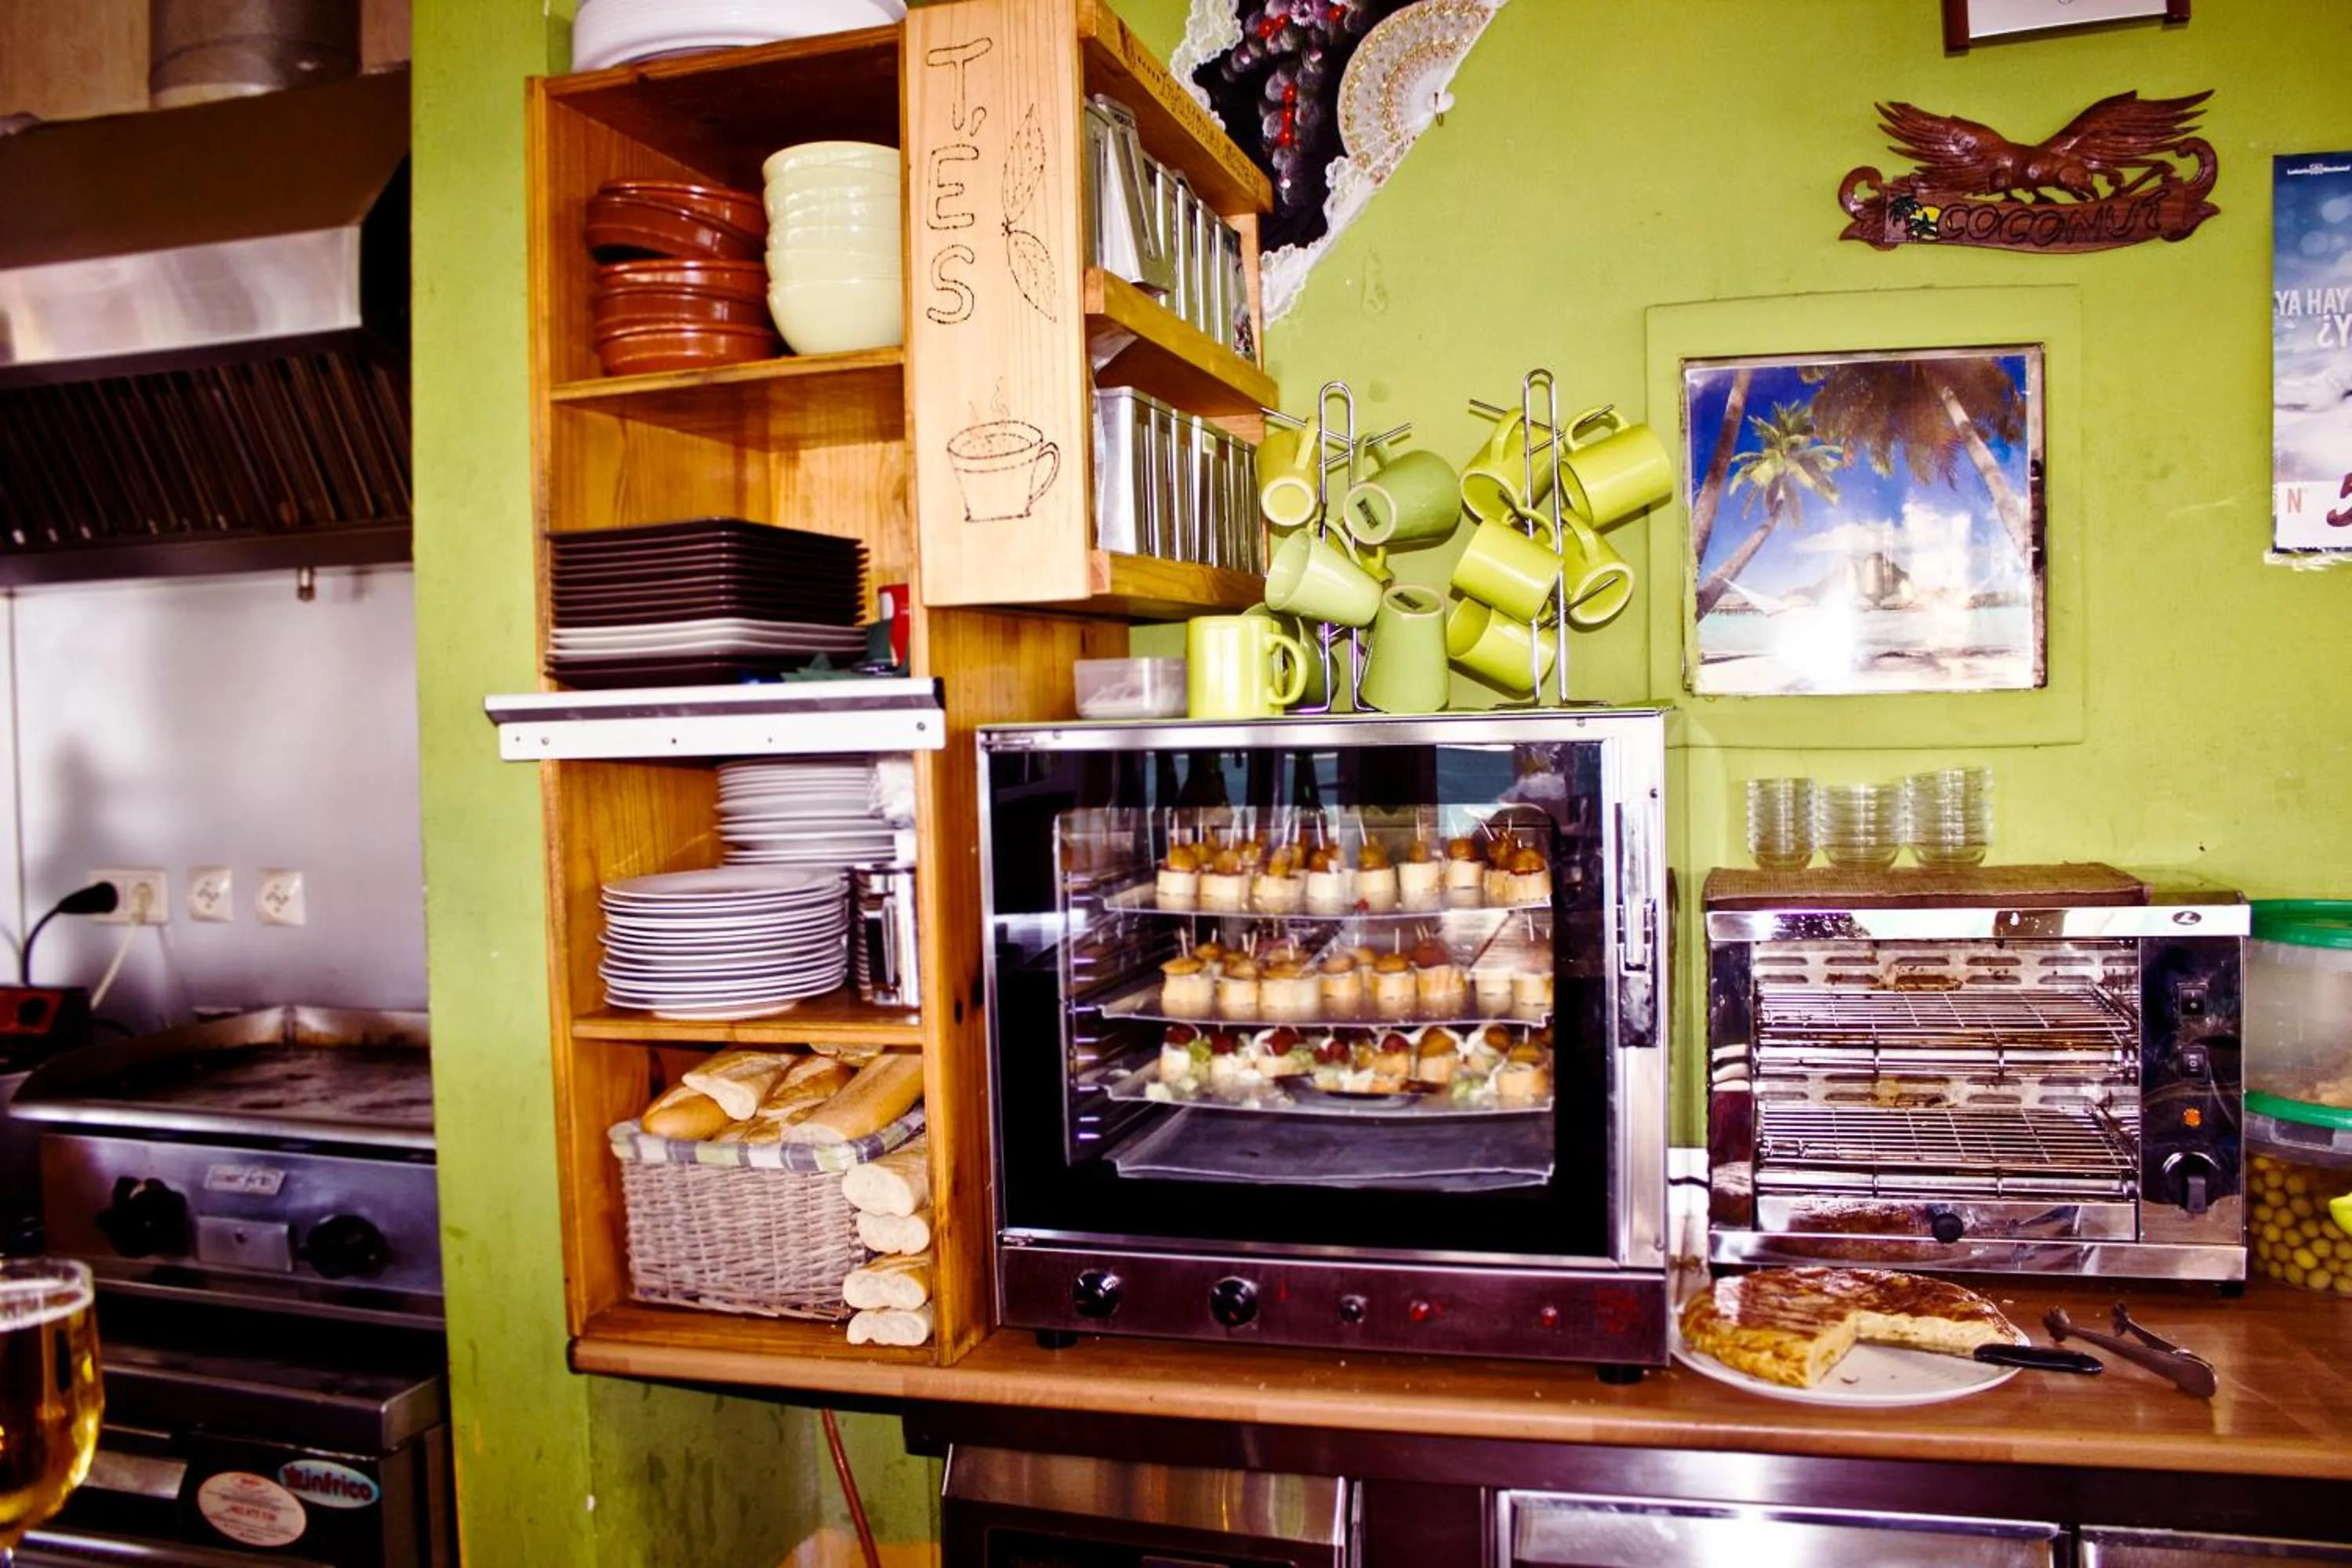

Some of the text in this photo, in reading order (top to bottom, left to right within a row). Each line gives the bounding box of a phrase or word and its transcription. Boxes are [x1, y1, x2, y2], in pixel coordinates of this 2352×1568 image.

[1937, 189, 2171, 246] COCONUT
[2274, 287, 2352, 316] YA HAY
[304, 1467, 373, 1501] infrico
